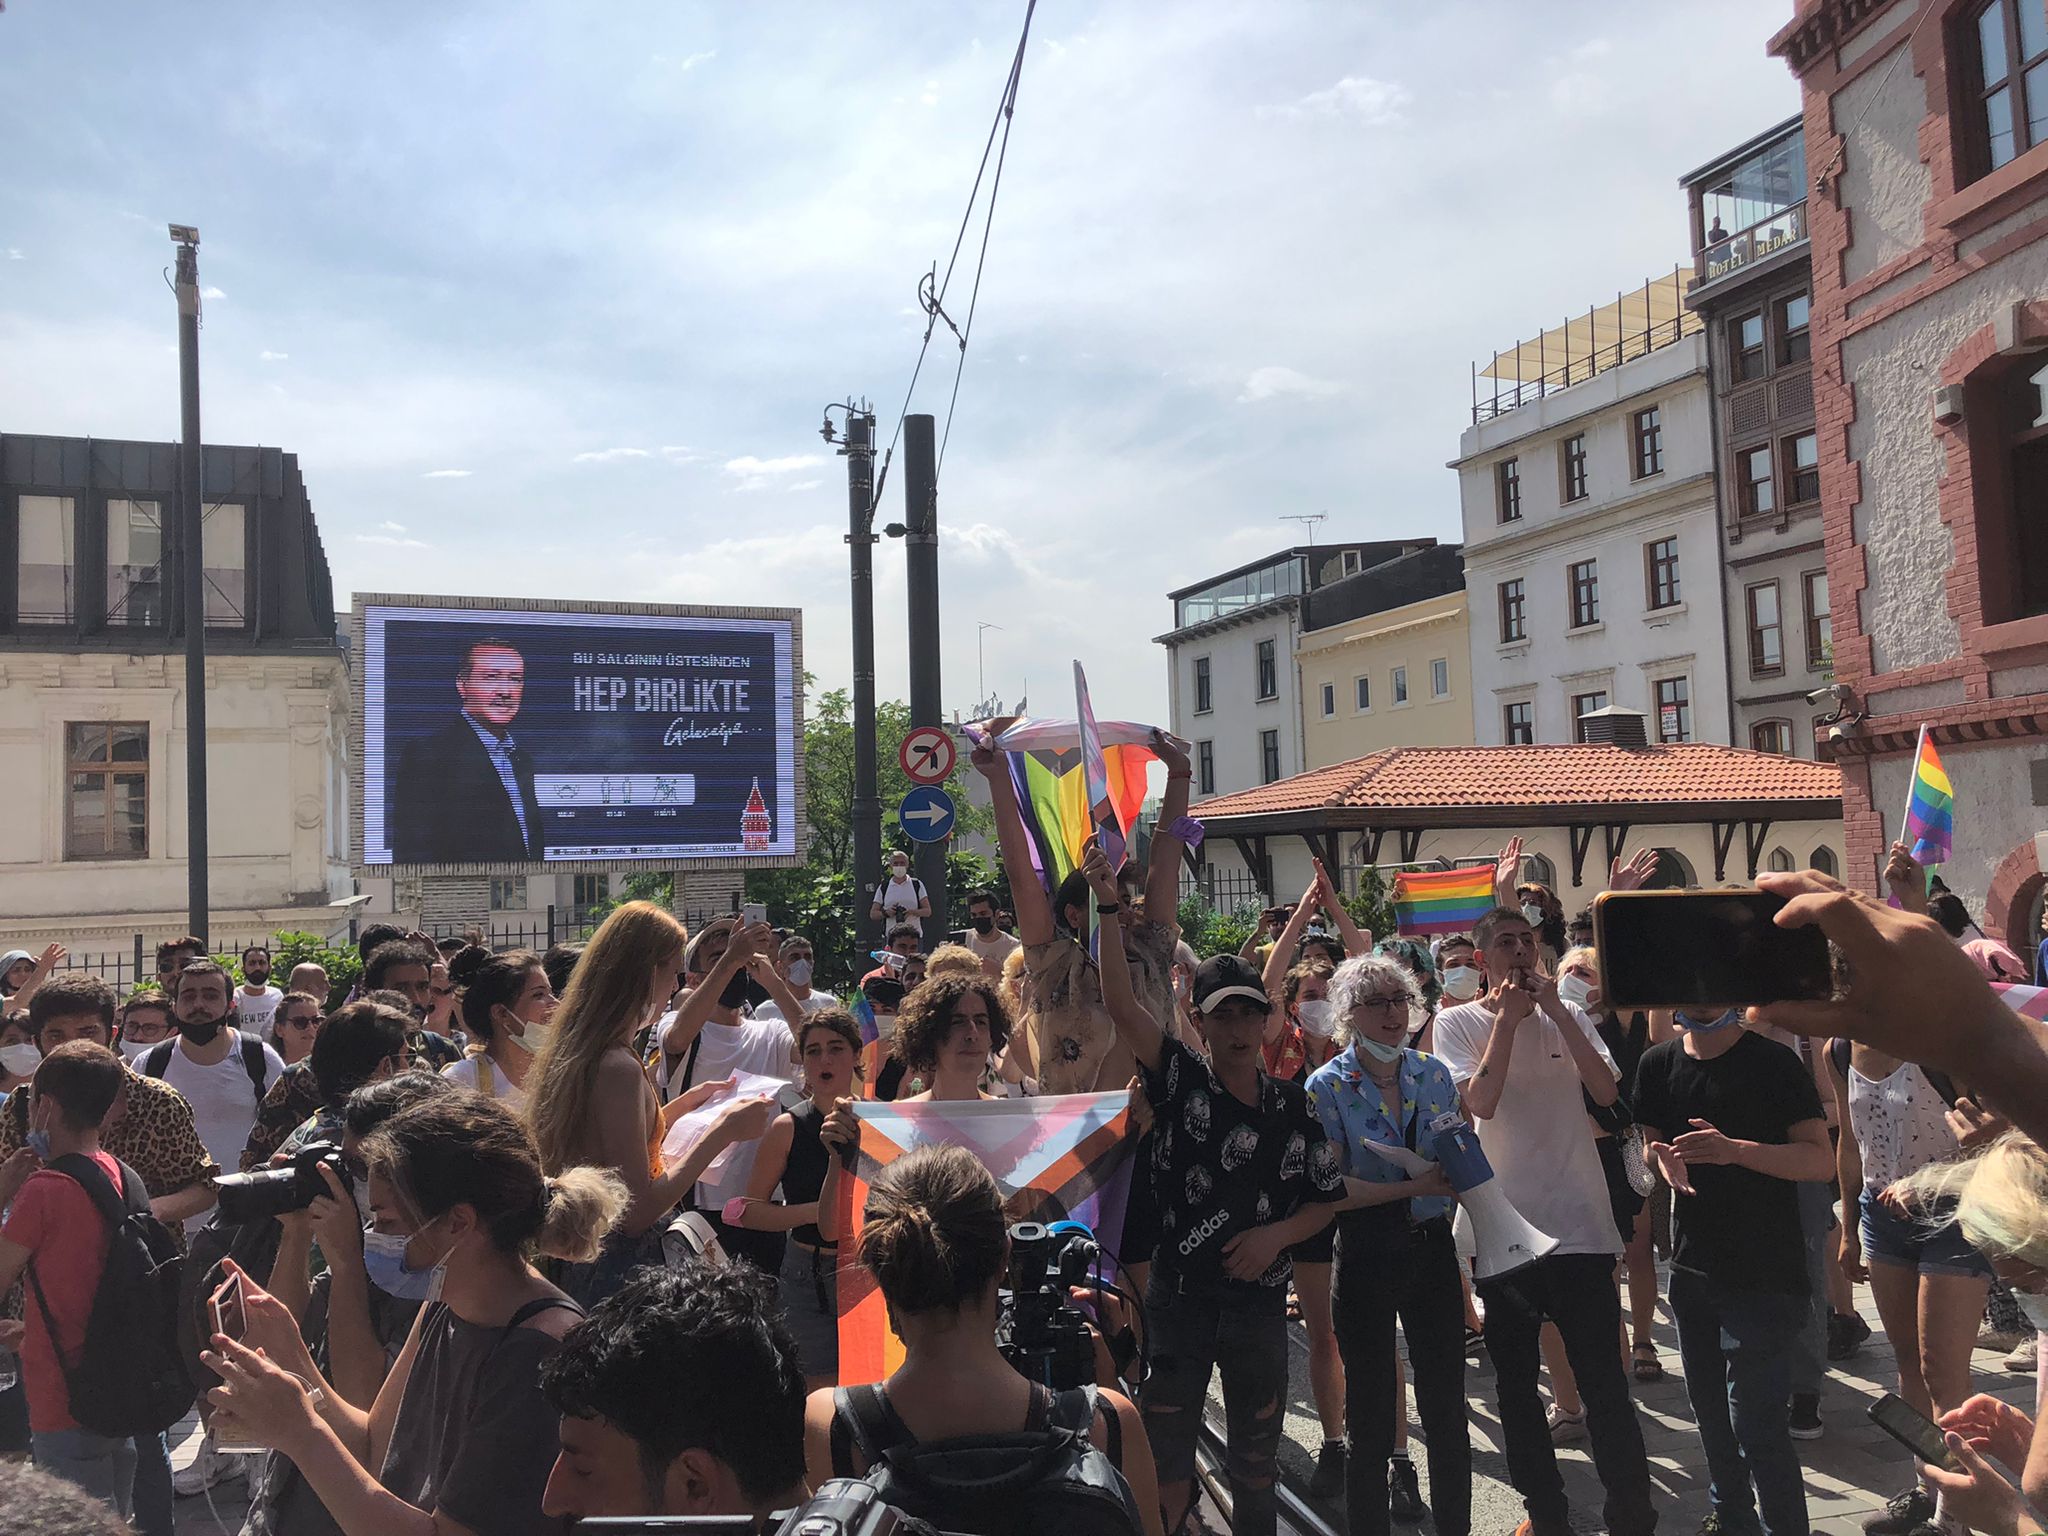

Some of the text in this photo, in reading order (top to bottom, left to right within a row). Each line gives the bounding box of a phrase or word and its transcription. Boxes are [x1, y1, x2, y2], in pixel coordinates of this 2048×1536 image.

[1709, 256, 1745, 279] HOTEL
[573, 653, 593, 664] BU
[597, 653, 663, 666] SALGININ
[573, 676, 627, 712] HEP
[1178, 1208, 1230, 1256] adidas
